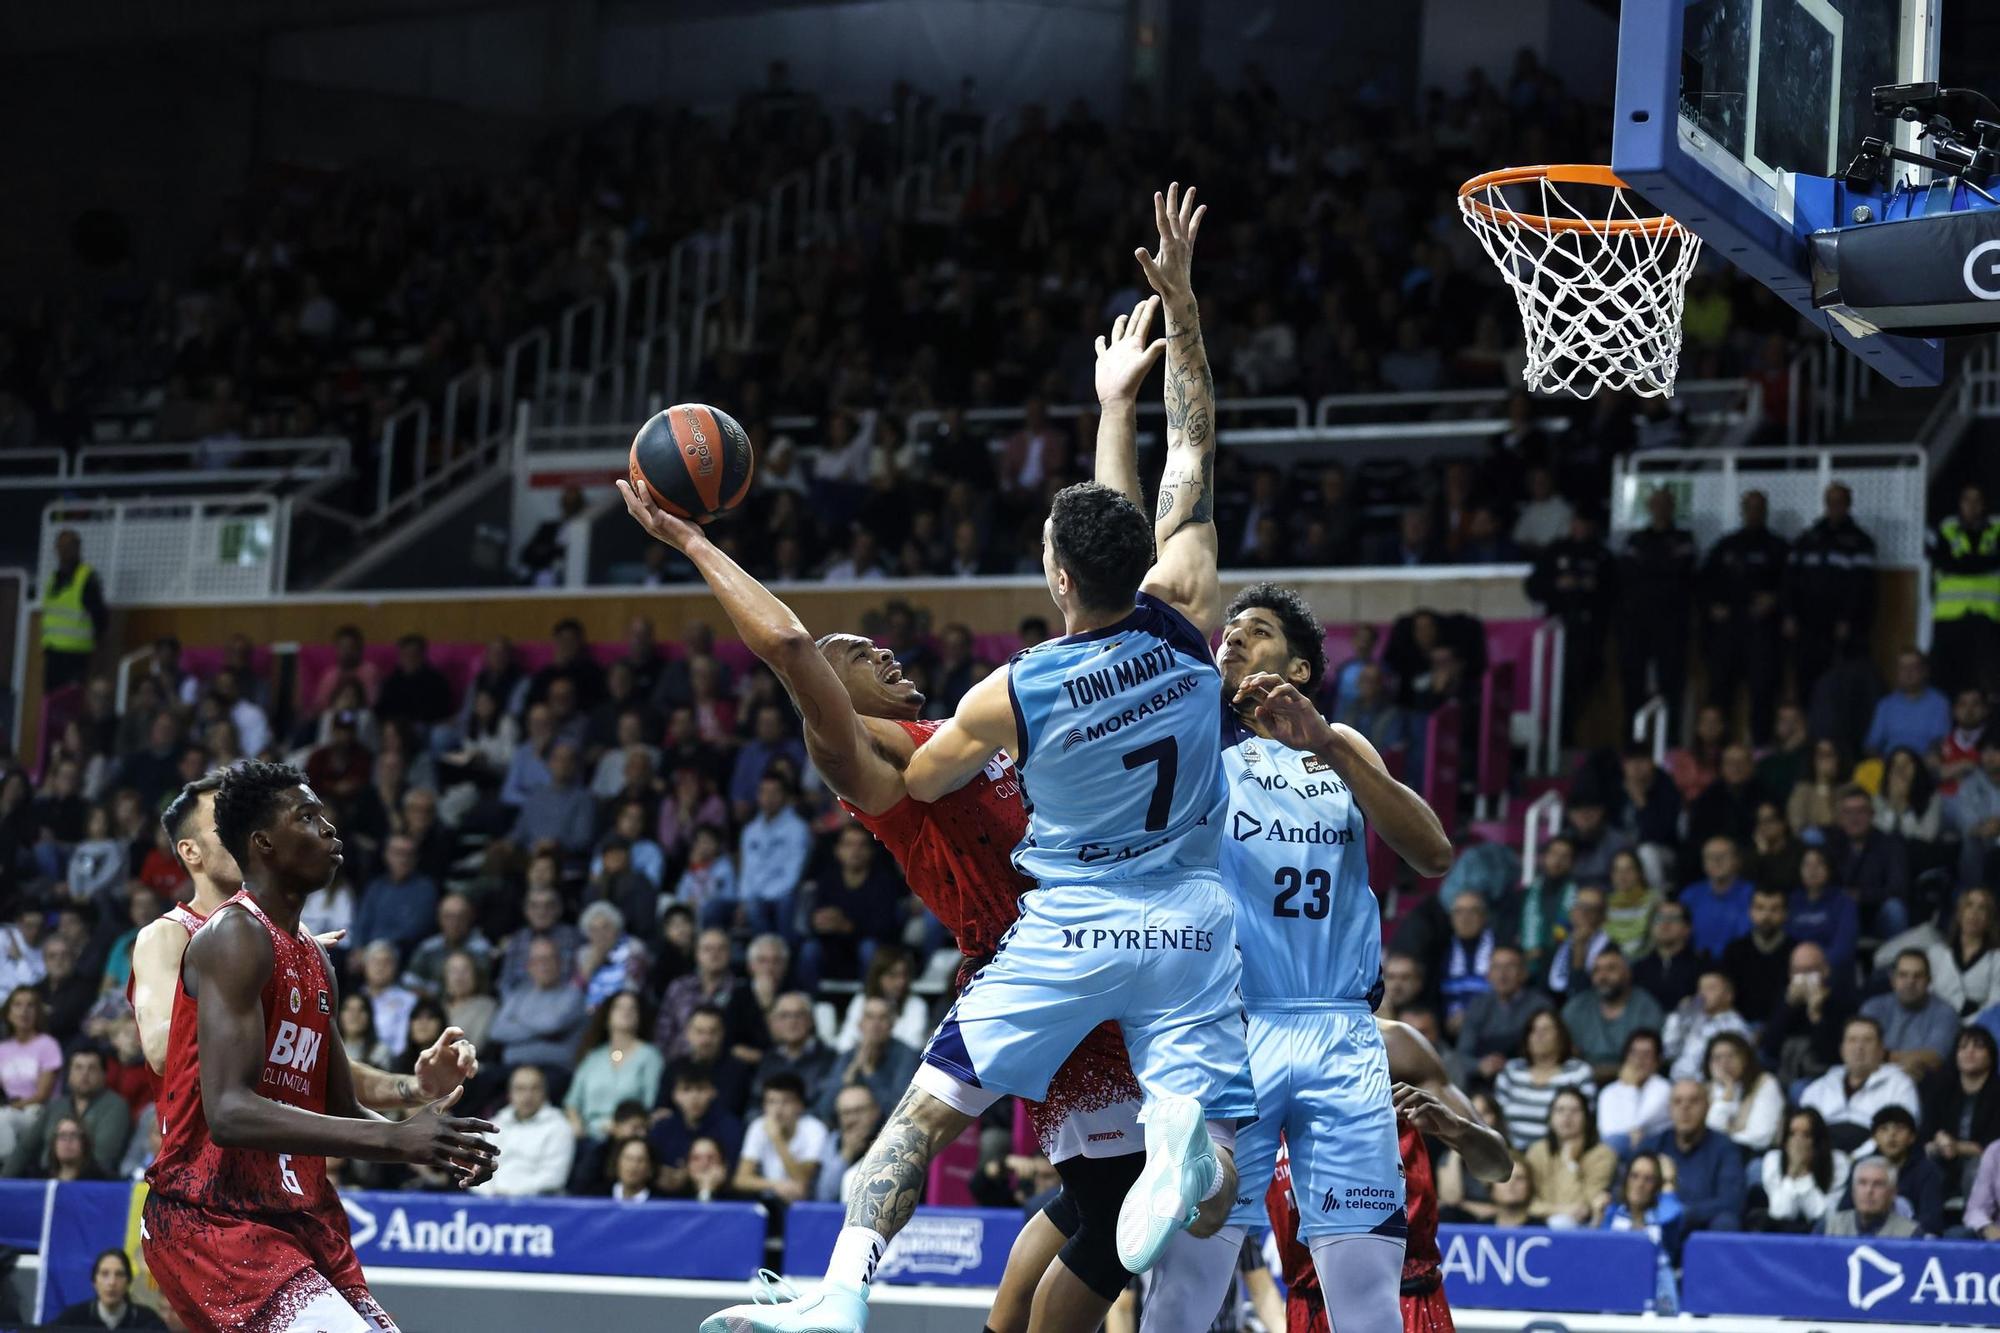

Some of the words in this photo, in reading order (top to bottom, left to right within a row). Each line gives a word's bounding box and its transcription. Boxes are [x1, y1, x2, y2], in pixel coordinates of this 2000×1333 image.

[1062, 668, 1116, 709] TONI
[1086, 675, 1199, 742] MORABANC
[1122, 735, 1178, 832] 7
[1273, 866, 1332, 920] 23
[1345, 1186, 1395, 1199] andorra
[1345, 1198, 1397, 1211] telecom
[378, 1206, 555, 1258] Andorra
[1435, 1233, 1552, 1288] ANC
